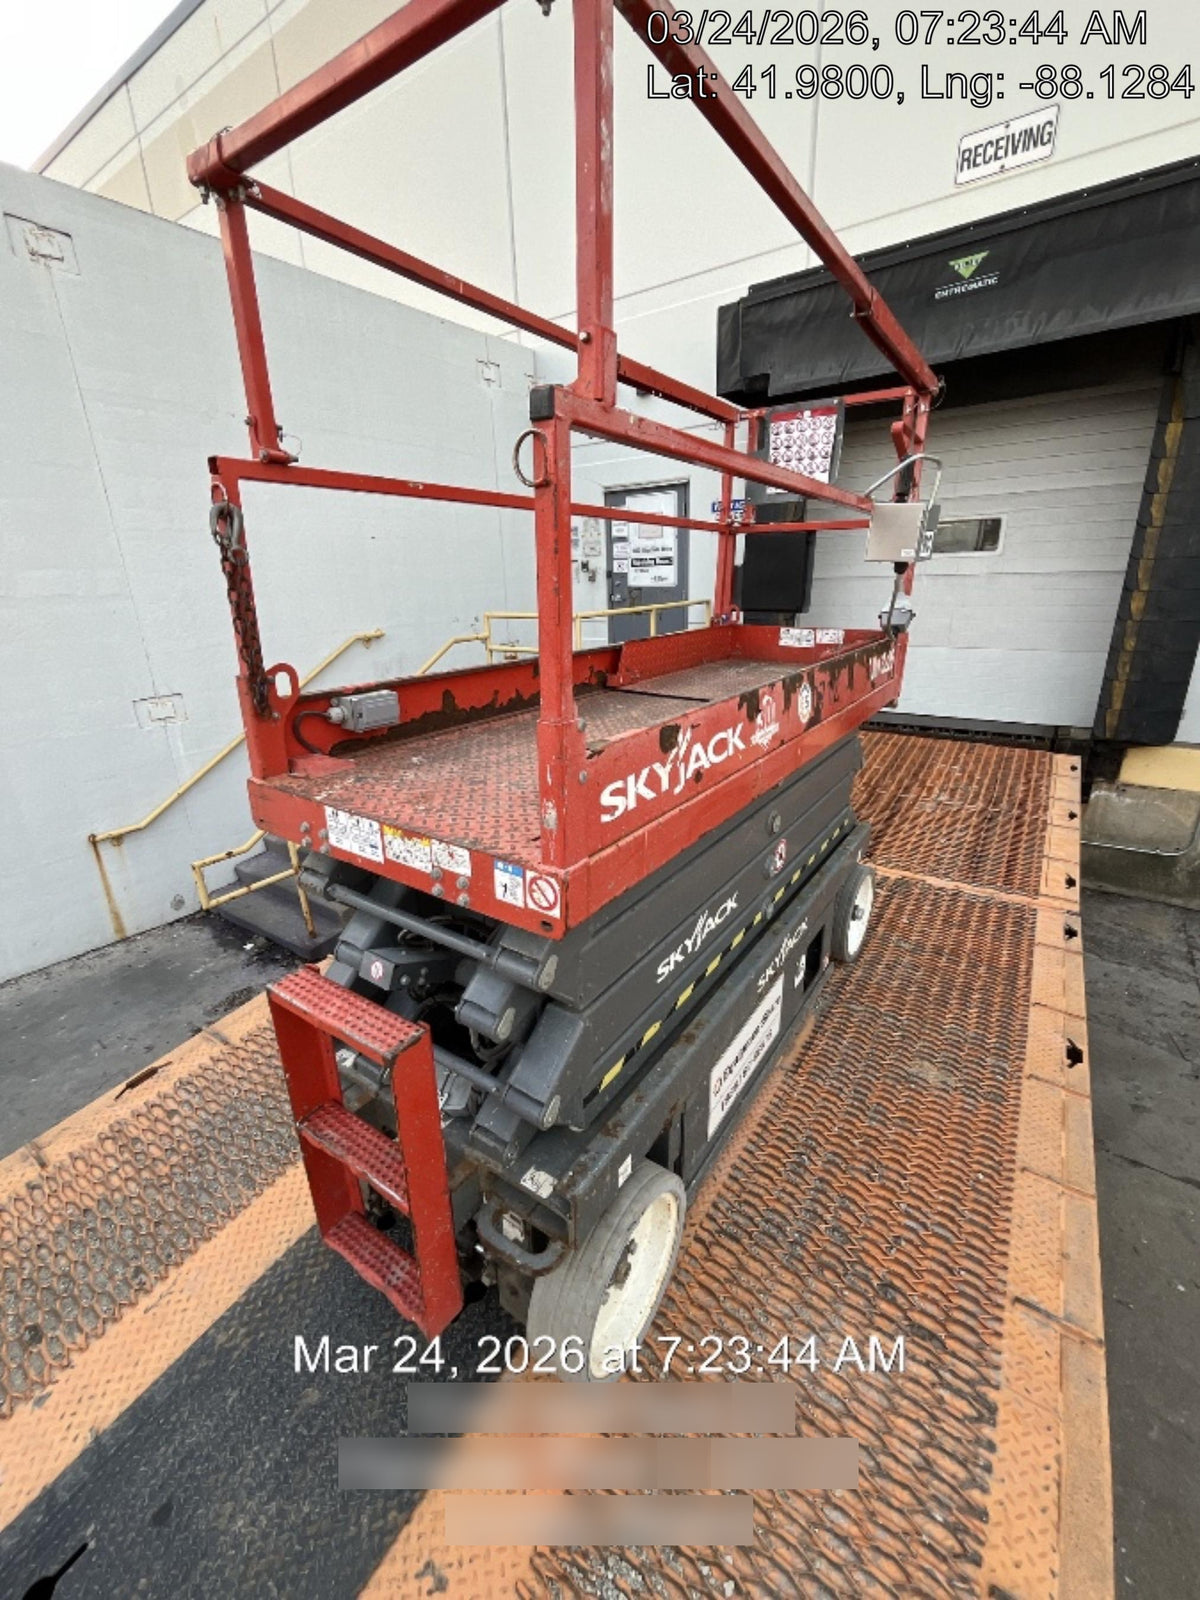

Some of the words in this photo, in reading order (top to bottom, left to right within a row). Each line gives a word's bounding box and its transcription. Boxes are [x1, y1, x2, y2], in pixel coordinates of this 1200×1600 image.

[960, 120, 1054, 173] RECEIVING
[599, 722, 746, 823] SKYJACK
[656, 889, 739, 984] SKYJACK
[757, 917, 808, 993] SKYJACK
